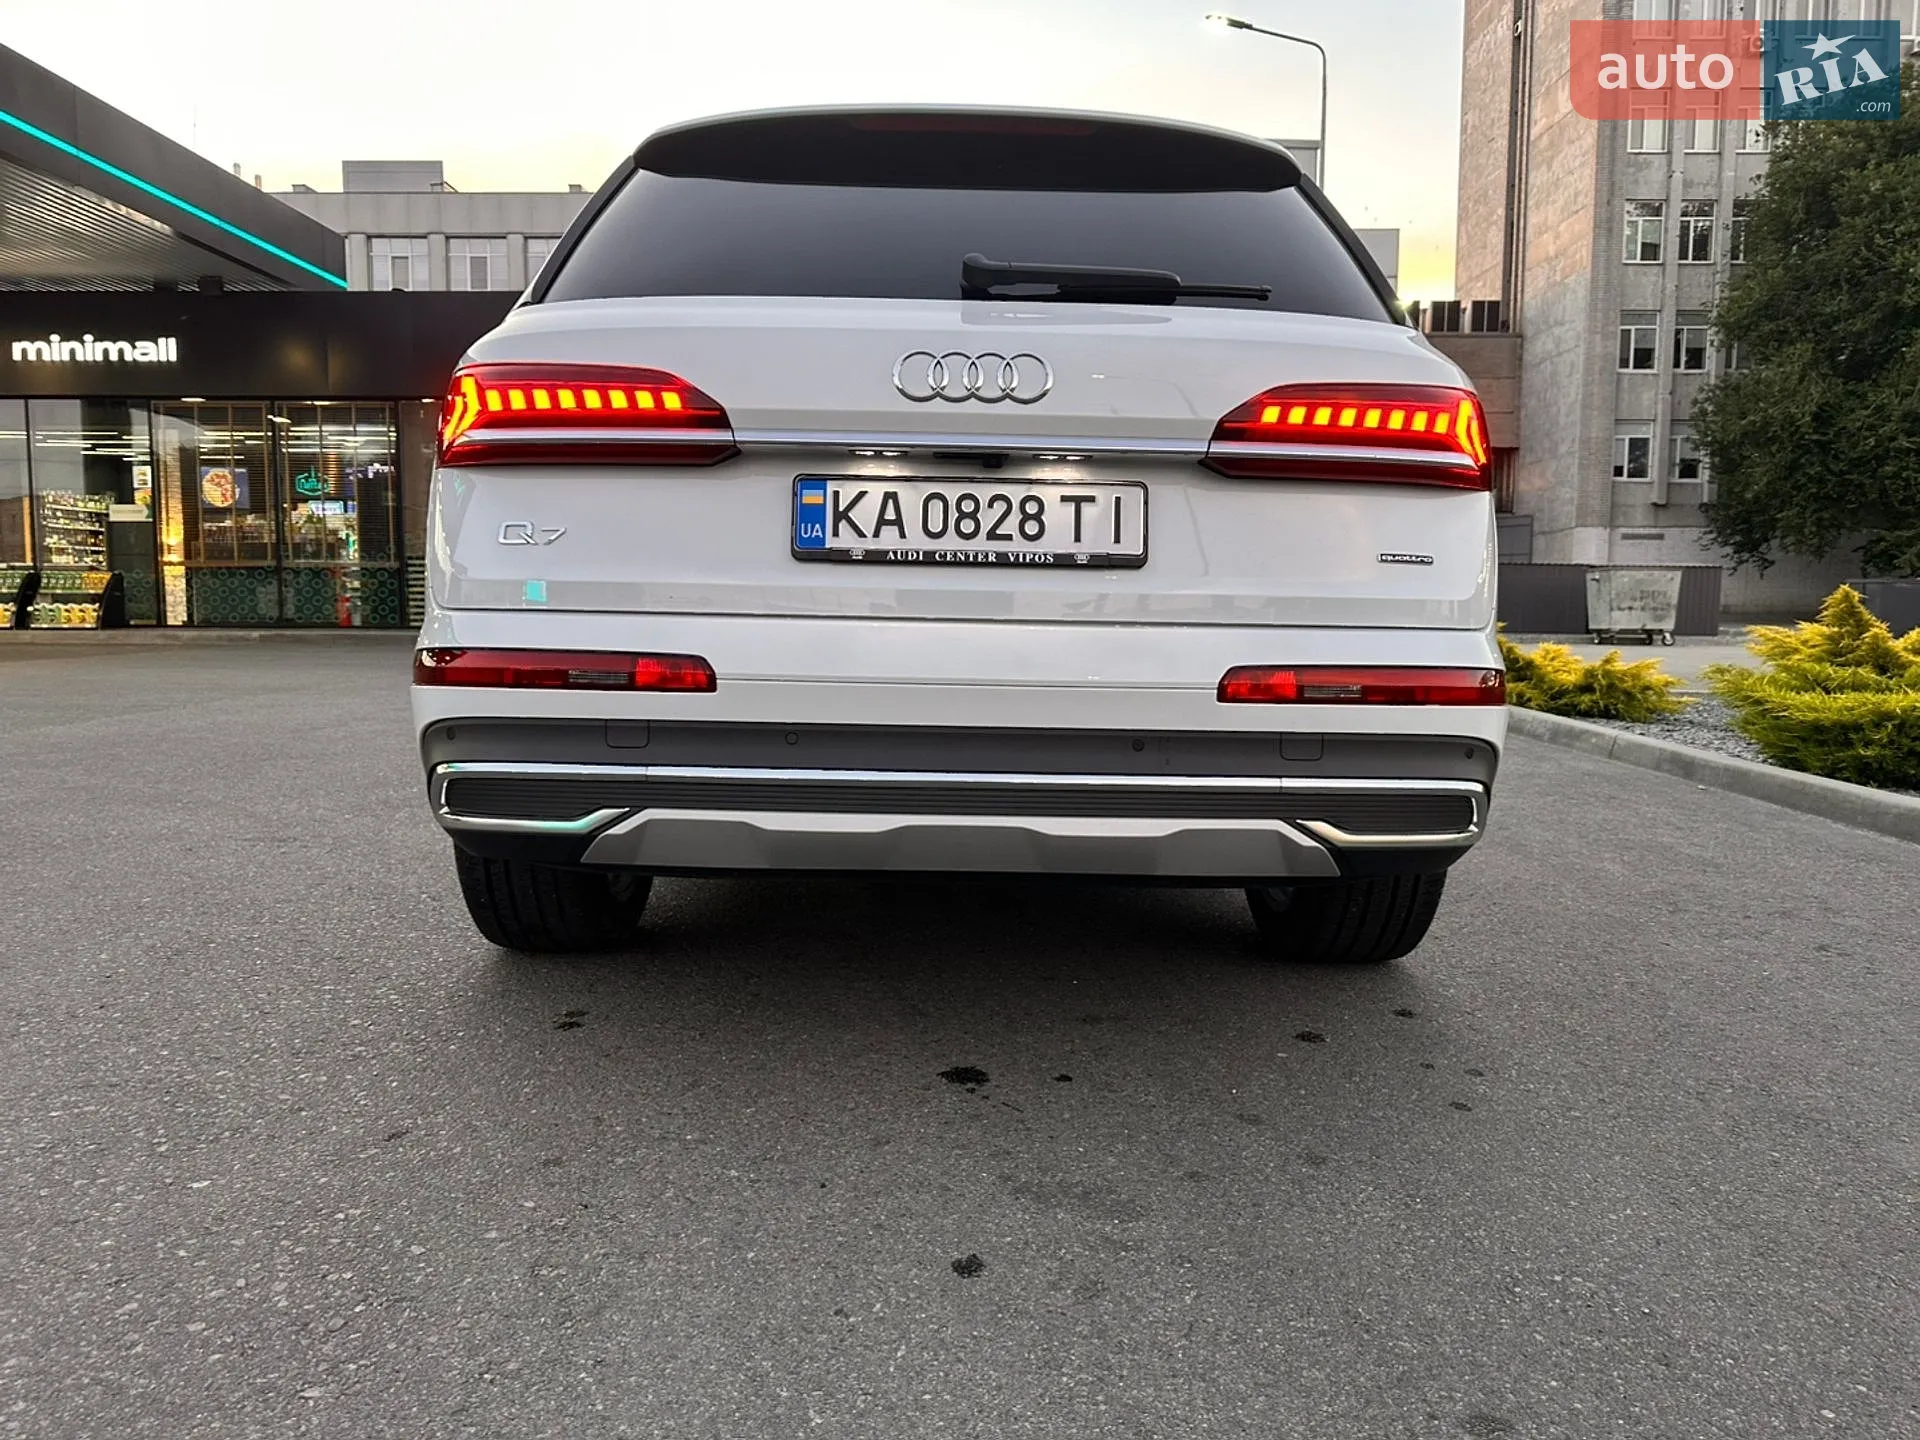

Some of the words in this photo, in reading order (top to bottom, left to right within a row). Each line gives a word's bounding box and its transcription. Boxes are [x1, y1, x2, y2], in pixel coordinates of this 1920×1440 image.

[11, 333, 178, 363] minimall
[831, 490, 908, 540] KA
[920, 492, 1047, 543] 0828
[1060, 494, 1122, 545] TI
[497, 521, 568, 546] Q7
[801, 523, 824, 539] UA
[886, 551, 924, 562] AUDI
[935, 551, 997, 563] CENTER
[1008, 552, 1055, 564] VIPOS
[1381, 554, 1433, 564] quattro
